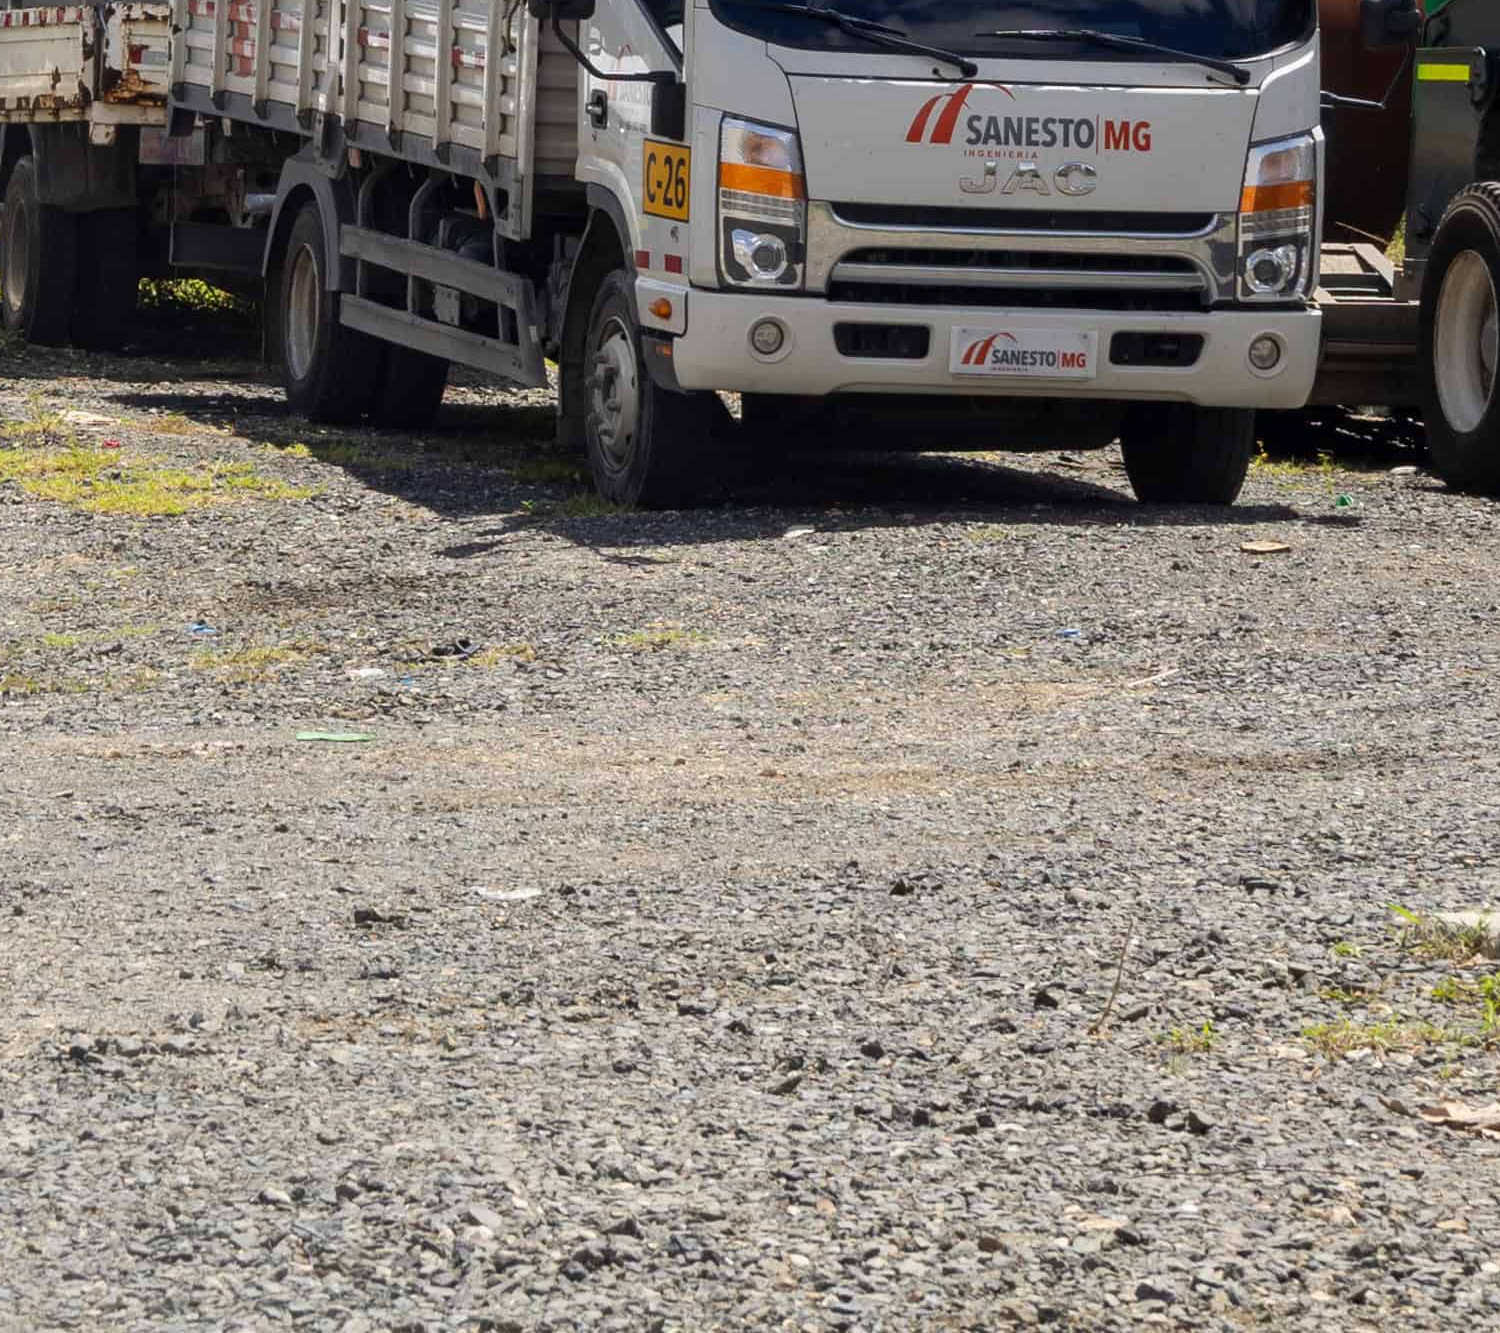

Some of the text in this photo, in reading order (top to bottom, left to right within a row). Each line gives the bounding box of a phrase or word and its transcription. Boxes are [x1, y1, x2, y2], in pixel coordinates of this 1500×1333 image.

[965, 114, 1152, 152] SANESTO MG
[646, 151, 686, 209] C-26
[959, 161, 1097, 197] JAC
[991, 348, 1087, 368] SANESTO MG
